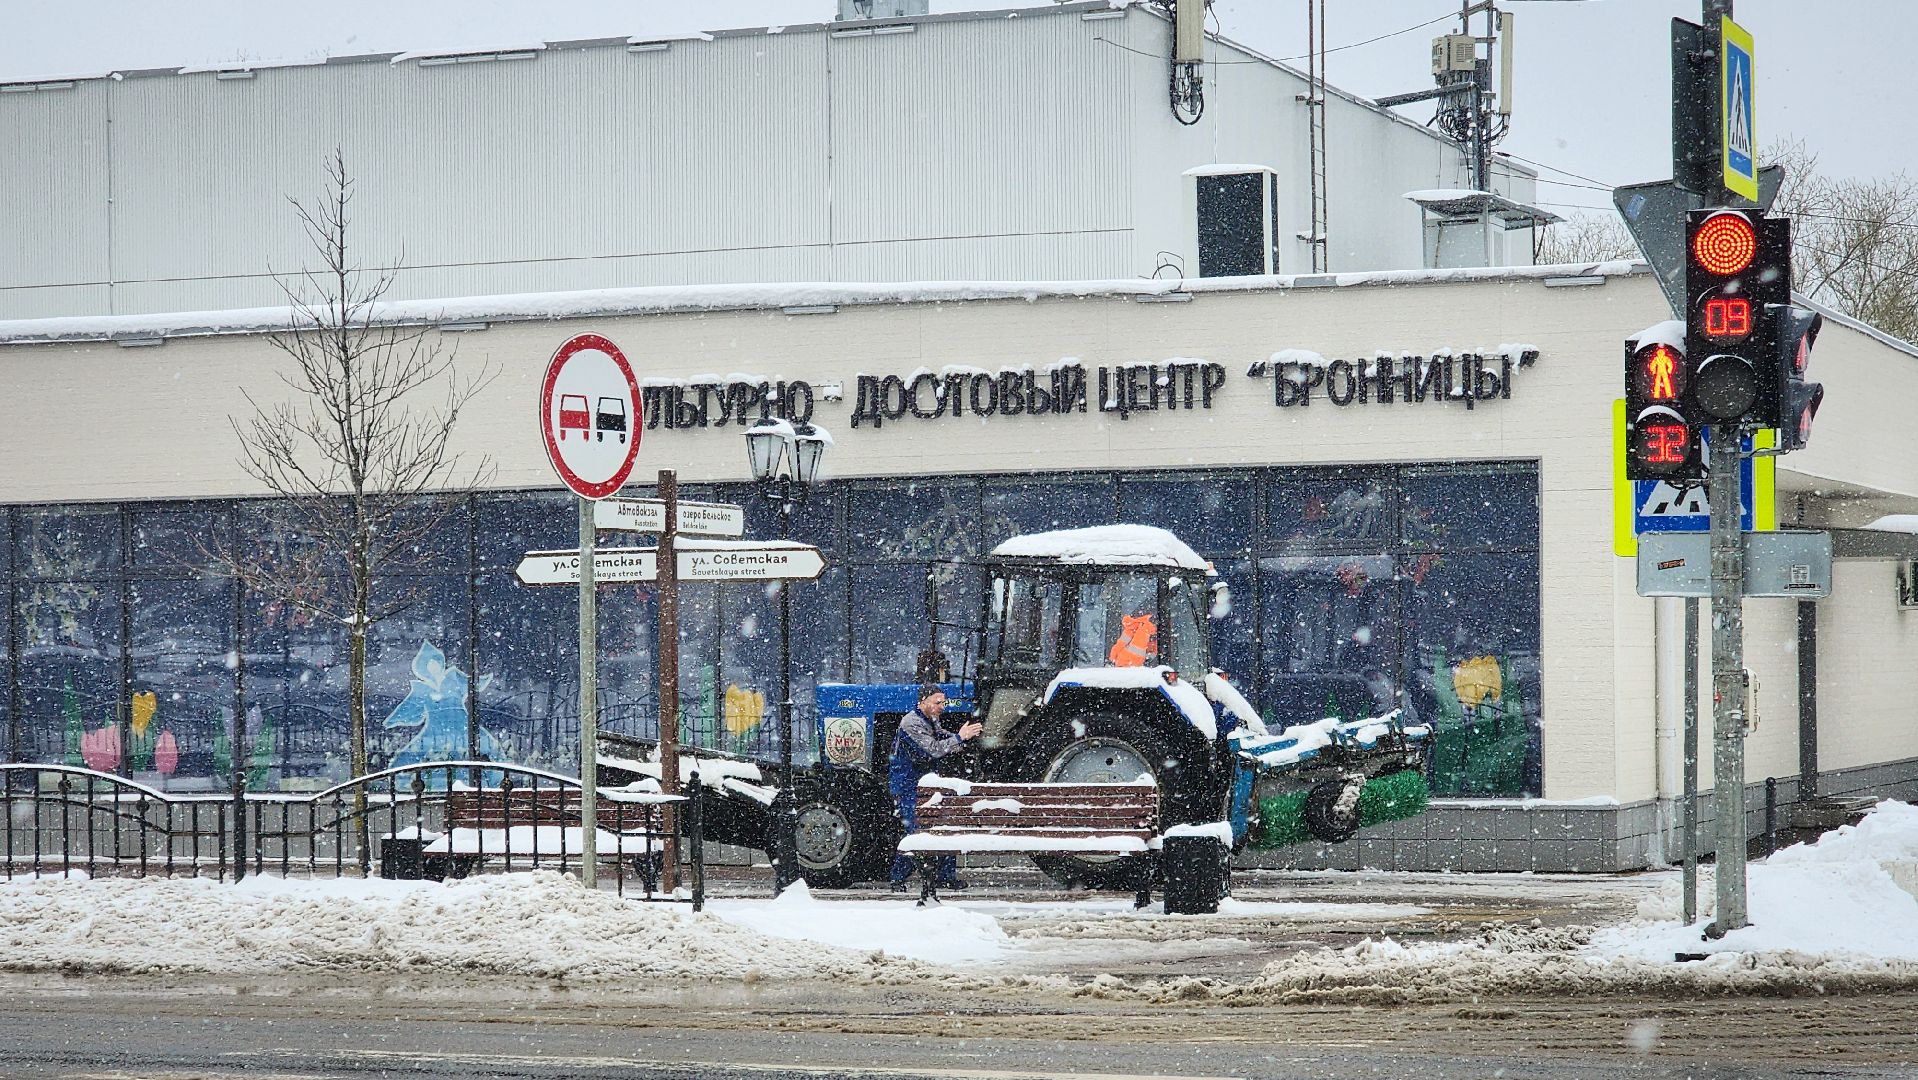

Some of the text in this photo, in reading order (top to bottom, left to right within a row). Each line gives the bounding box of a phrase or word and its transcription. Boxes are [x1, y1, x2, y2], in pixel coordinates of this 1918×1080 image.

[1706, 299, 1750, 336] 09
[851, 363, 1087, 429] ДОСУГОВЫЙ
[1098, 362, 1226, 421] ЦЕНТР
[1646, 425, 1687, 463] 32
[617, 503, 658, 517] Автовокзал
[683, 510, 702, 522] озеро
[691, 553, 788, 568] ул. Советская
[691, 568, 739, 577] Sovetskaya
